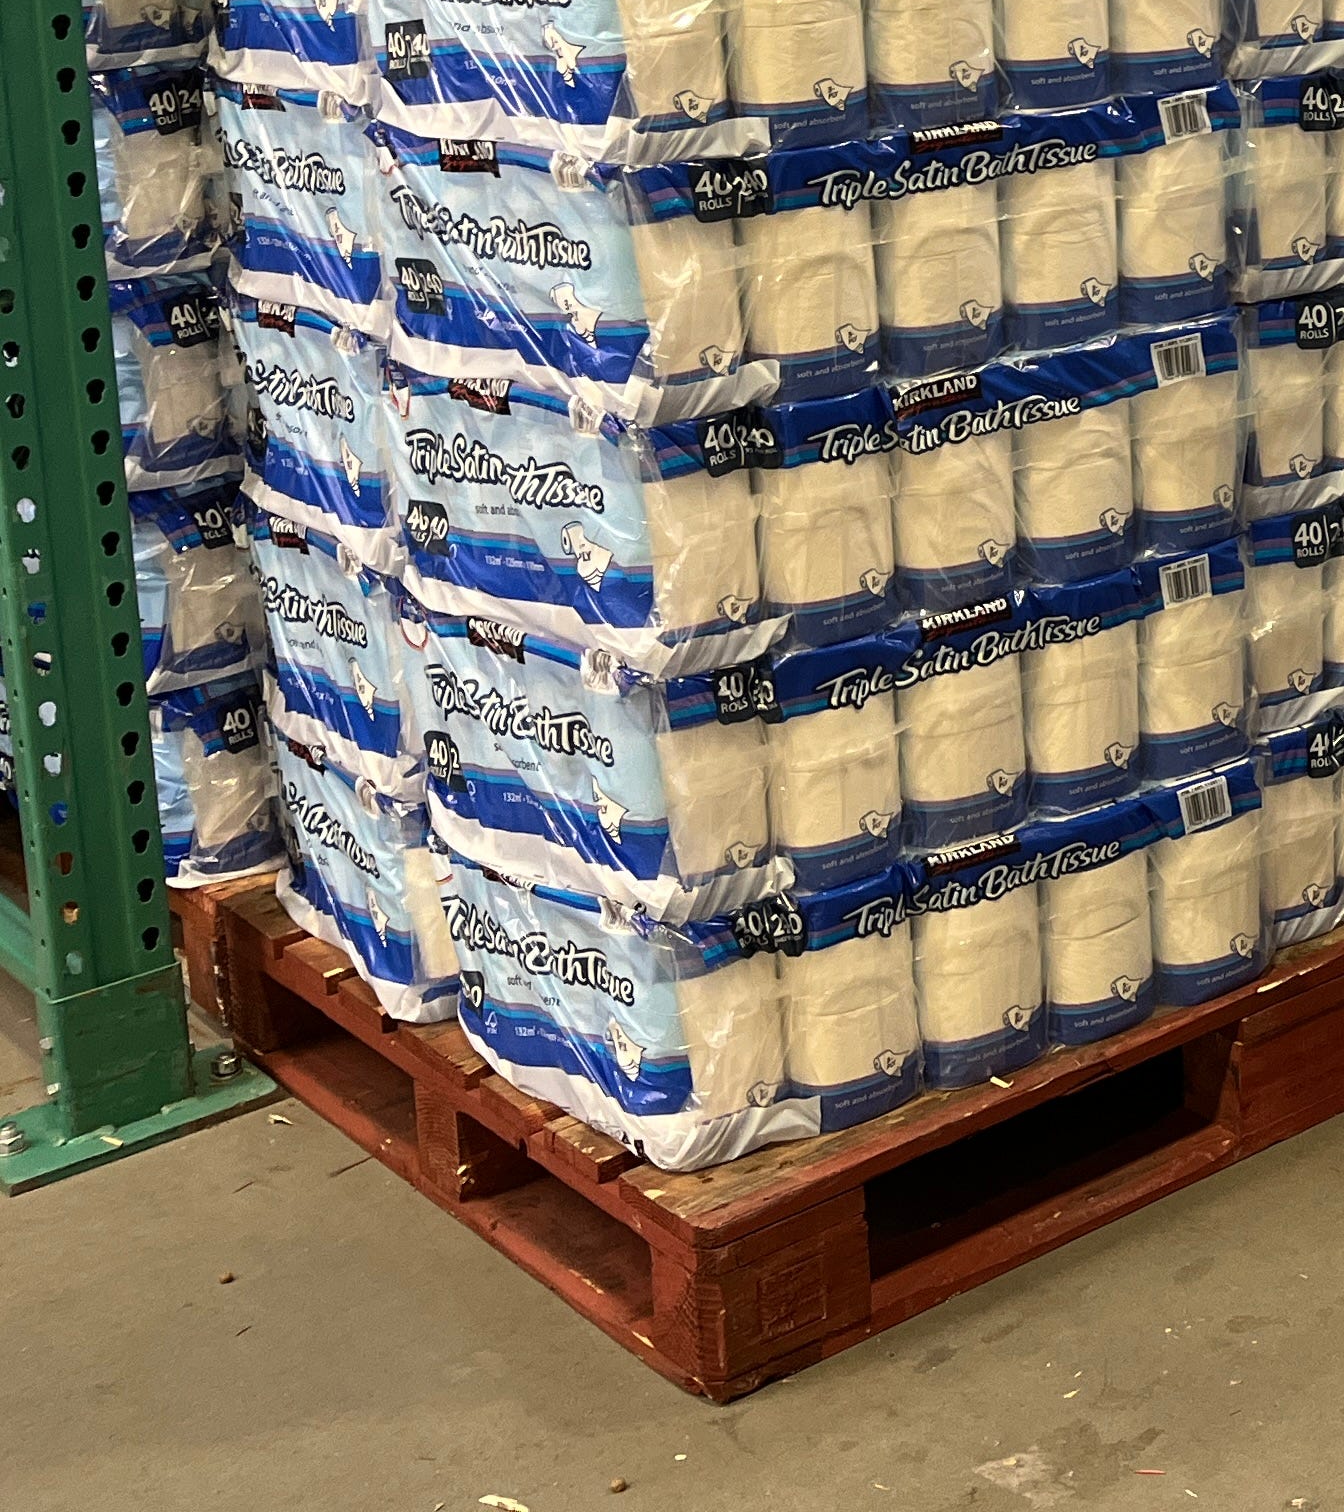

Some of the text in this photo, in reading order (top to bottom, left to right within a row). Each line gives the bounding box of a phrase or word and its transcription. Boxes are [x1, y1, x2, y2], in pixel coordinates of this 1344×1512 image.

[1300, 305, 1327, 328] 40
[923, 598, 1006, 630] KIRKLAND
[817, 644, 970, 709] Triple Satin
[1045, 840, 1120, 876] Tissue
